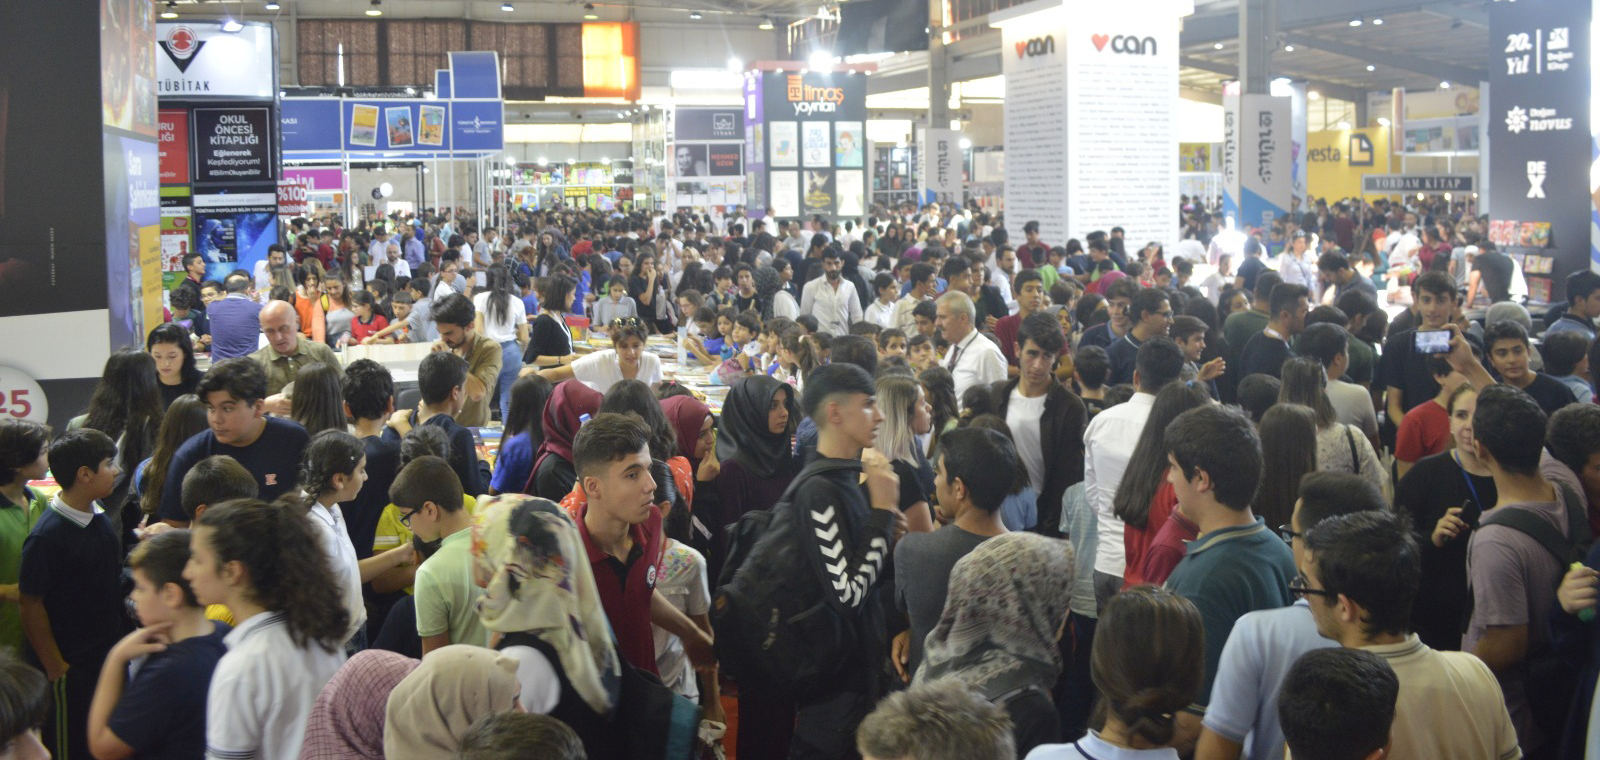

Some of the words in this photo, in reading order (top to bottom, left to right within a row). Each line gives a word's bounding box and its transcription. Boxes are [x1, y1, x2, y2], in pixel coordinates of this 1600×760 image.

[1026, 35, 1055, 57] can
[1111, 34, 1157, 56] can
[1504, 32, 1532, 53] 20.
[158, 79, 210, 91] TÜBİTAK
[804, 84, 845, 105] timaş
[220, 115, 248, 124] OKUL
[1529, 117, 1573, 131] novus
[214, 124, 253, 134] ÖNCESİ
[209, 134, 259, 145] KİTAPLIĞI
[213, 149, 252, 157] Eğlenerek
[1375, 178, 1420, 188] YORDAM
[1425, 177, 1461, 188] KİTAP
[277, 186, 308, 201] %100
